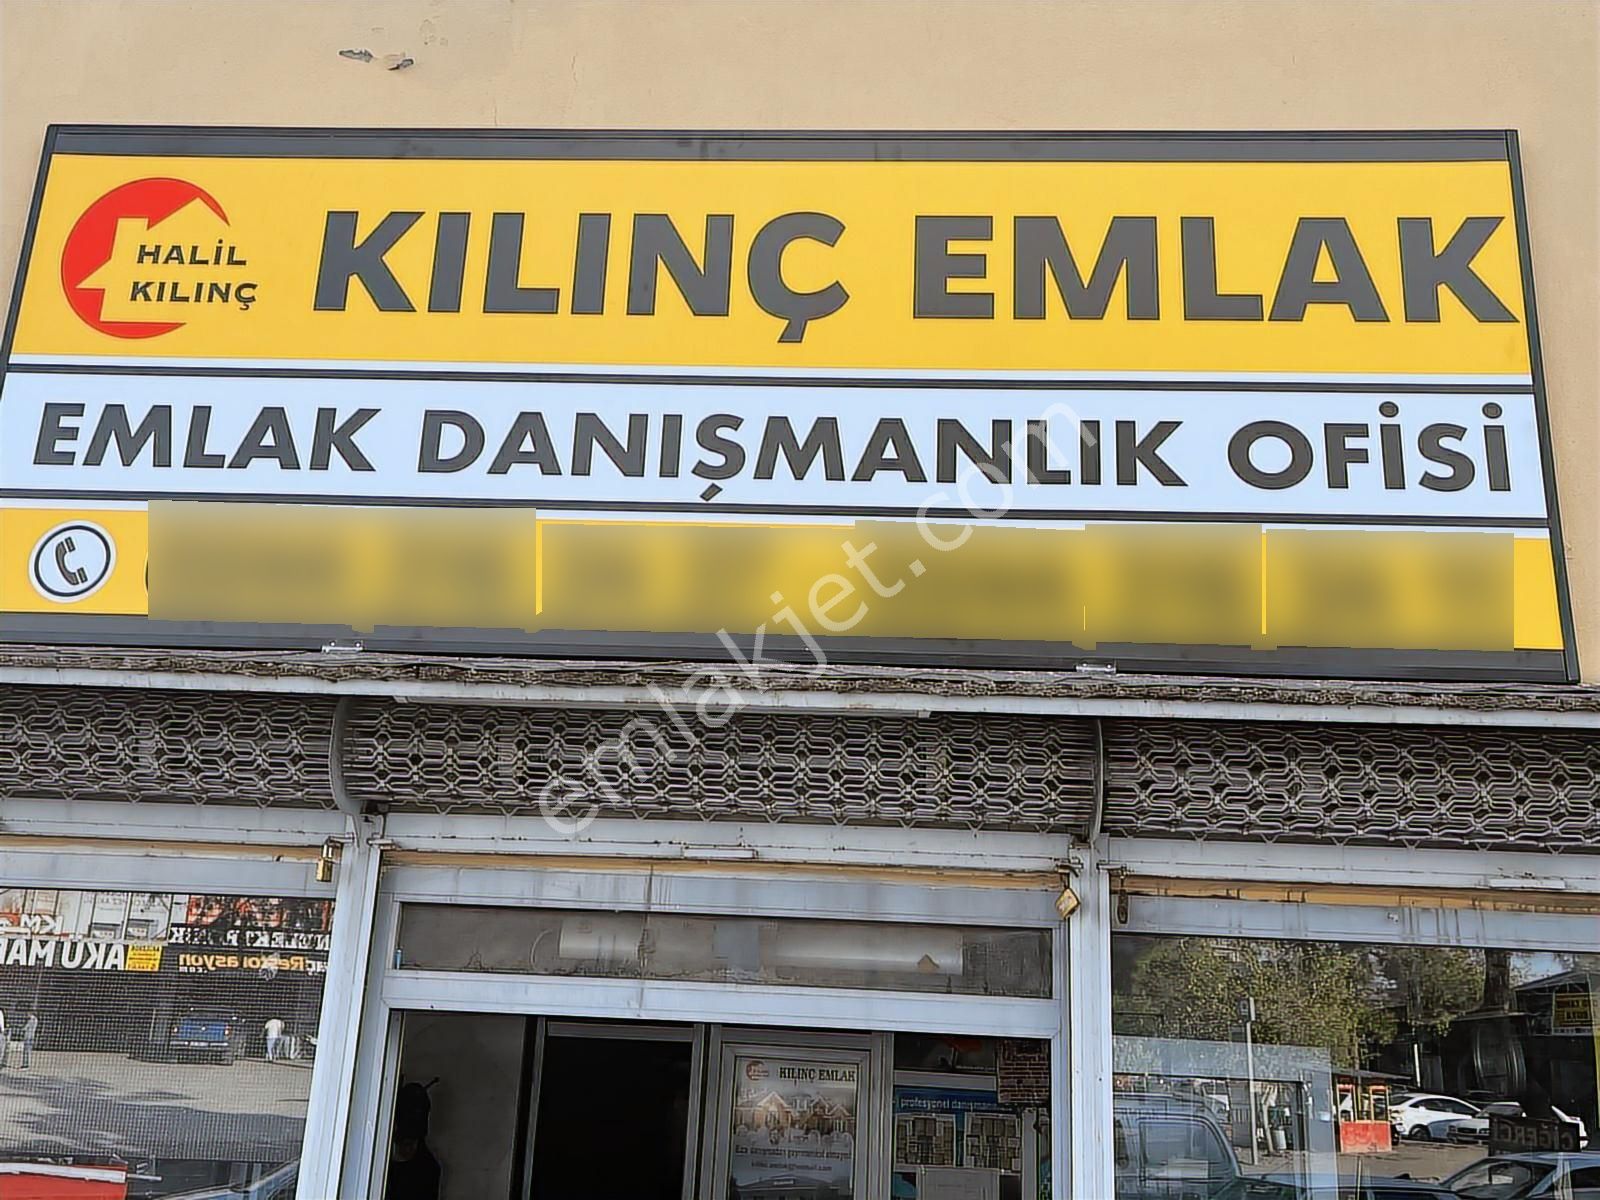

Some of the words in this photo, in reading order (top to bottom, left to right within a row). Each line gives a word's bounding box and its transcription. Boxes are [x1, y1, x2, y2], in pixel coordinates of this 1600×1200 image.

[136, 238, 248, 267] HALİL
[313, 210, 850, 344] KILINÇ
[913, 214, 1521, 324] EMLAK
[129, 280, 259, 312] KILINÇ
[32, 401, 382, 473] EMLAK
[417, 407, 1189, 501] DANIŞMANLIK
[1227, 400, 1512, 492] OFİSİ
